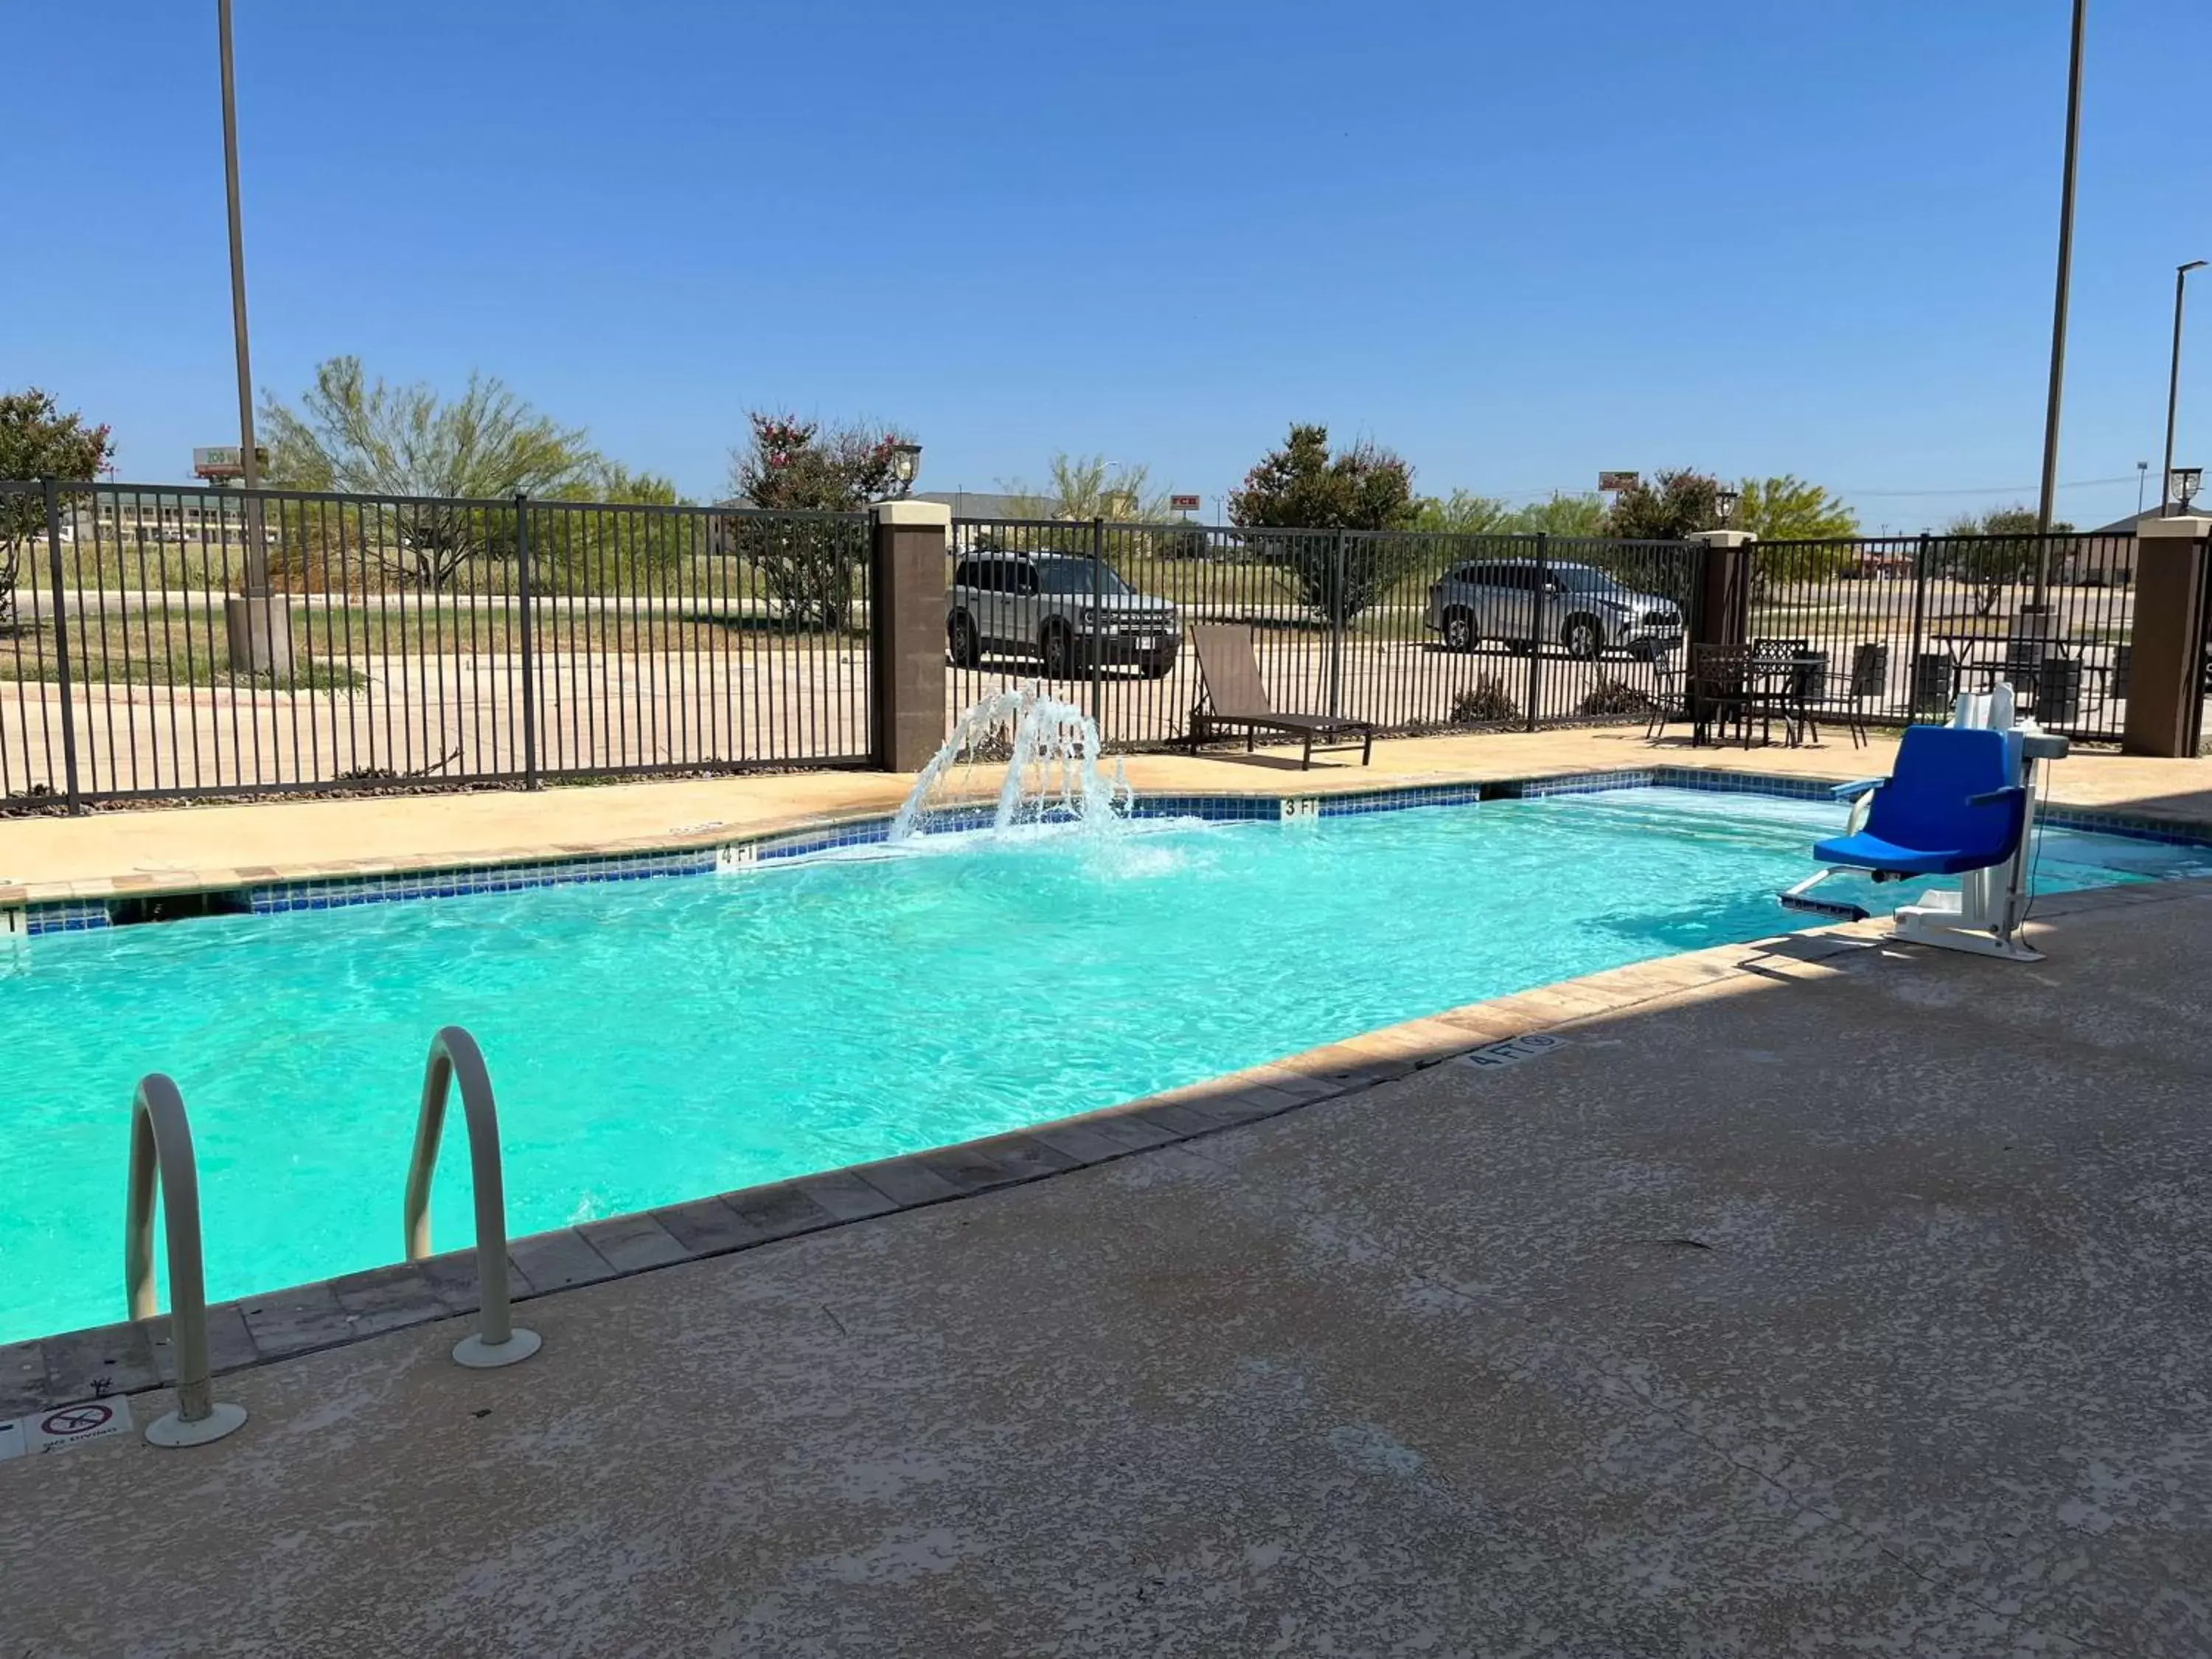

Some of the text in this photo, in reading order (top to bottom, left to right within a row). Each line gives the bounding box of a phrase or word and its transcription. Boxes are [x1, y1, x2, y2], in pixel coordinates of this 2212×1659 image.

[1285, 798, 1316, 815] 3 FT
[722, 839, 754, 864] 4 FT
[1469, 1043, 1534, 1065] 4 FT
